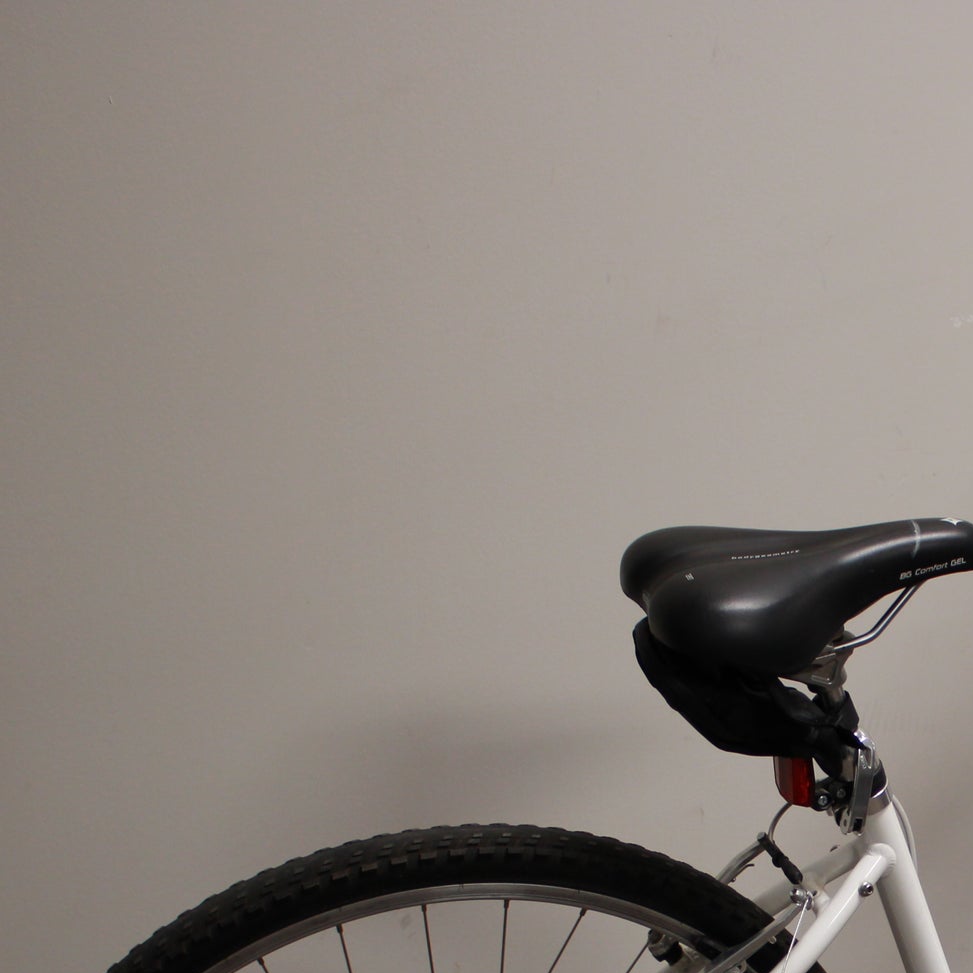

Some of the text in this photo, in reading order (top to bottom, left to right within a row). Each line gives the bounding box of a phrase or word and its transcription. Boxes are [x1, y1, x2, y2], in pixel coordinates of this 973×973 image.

[899, 557, 966, 580] BG Comfort GEL
